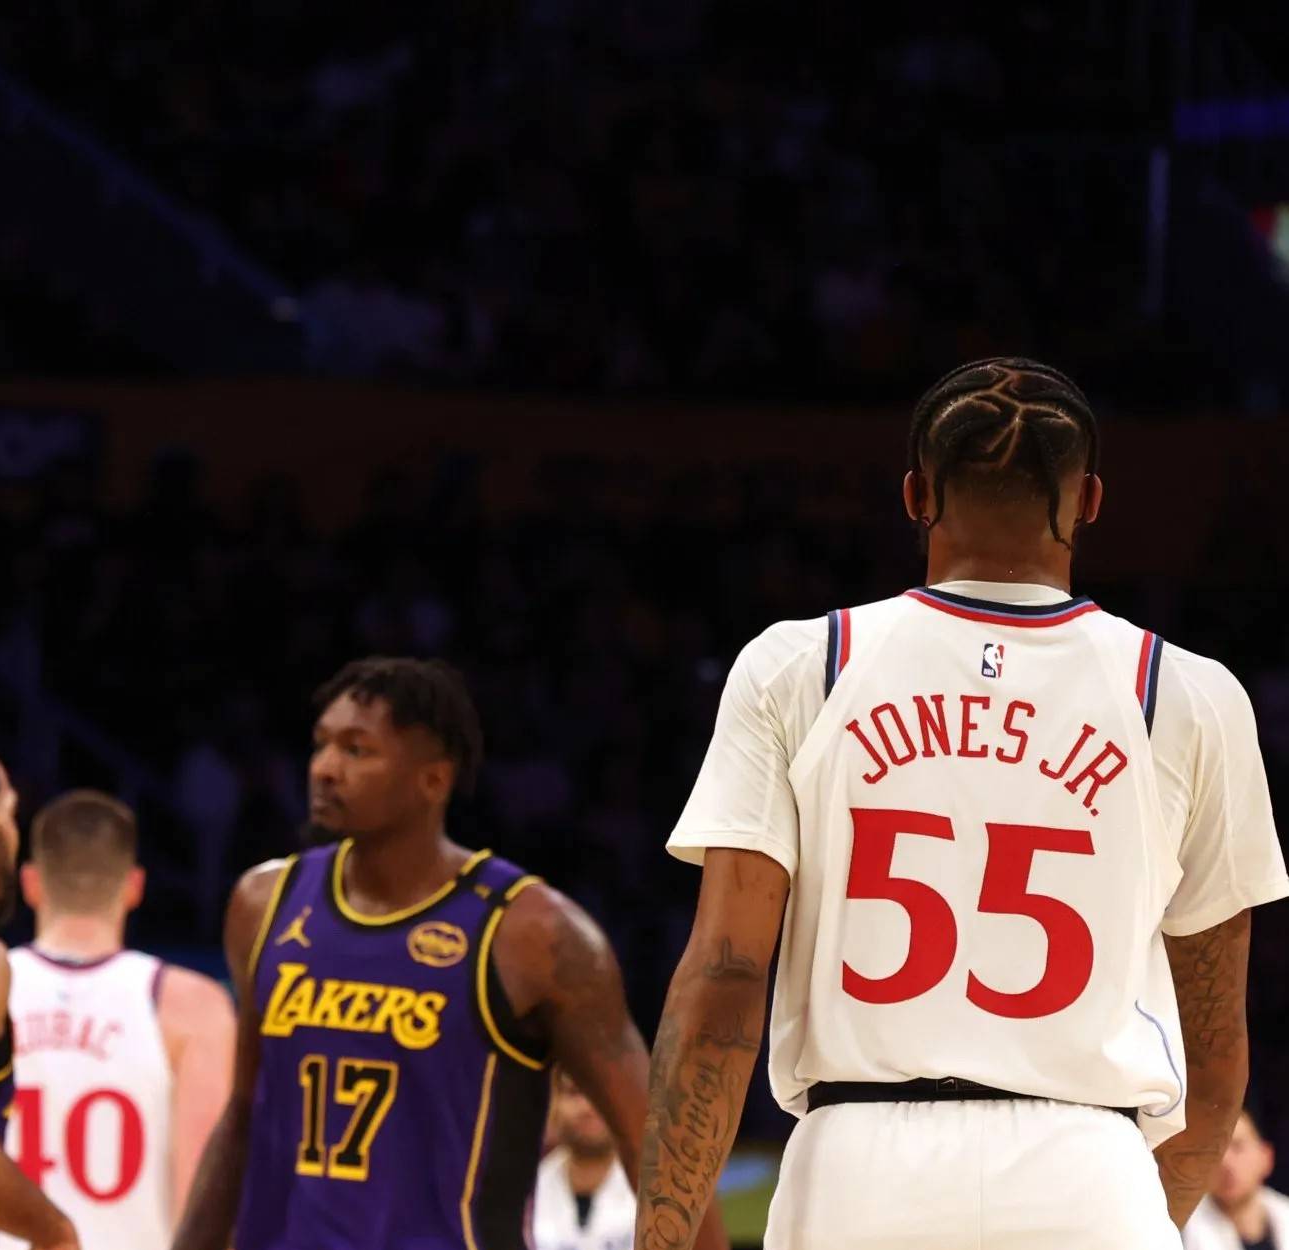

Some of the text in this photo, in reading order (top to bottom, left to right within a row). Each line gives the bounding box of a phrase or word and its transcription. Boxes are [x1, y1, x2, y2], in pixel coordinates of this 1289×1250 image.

[846, 694, 1128, 817] JONES JR.
[842, 807, 1096, 1019] 55
[260, 962, 448, 1050] LAKERS
[13, 1085, 146, 1204] 40
[295, 1054, 399, 1182] 17
